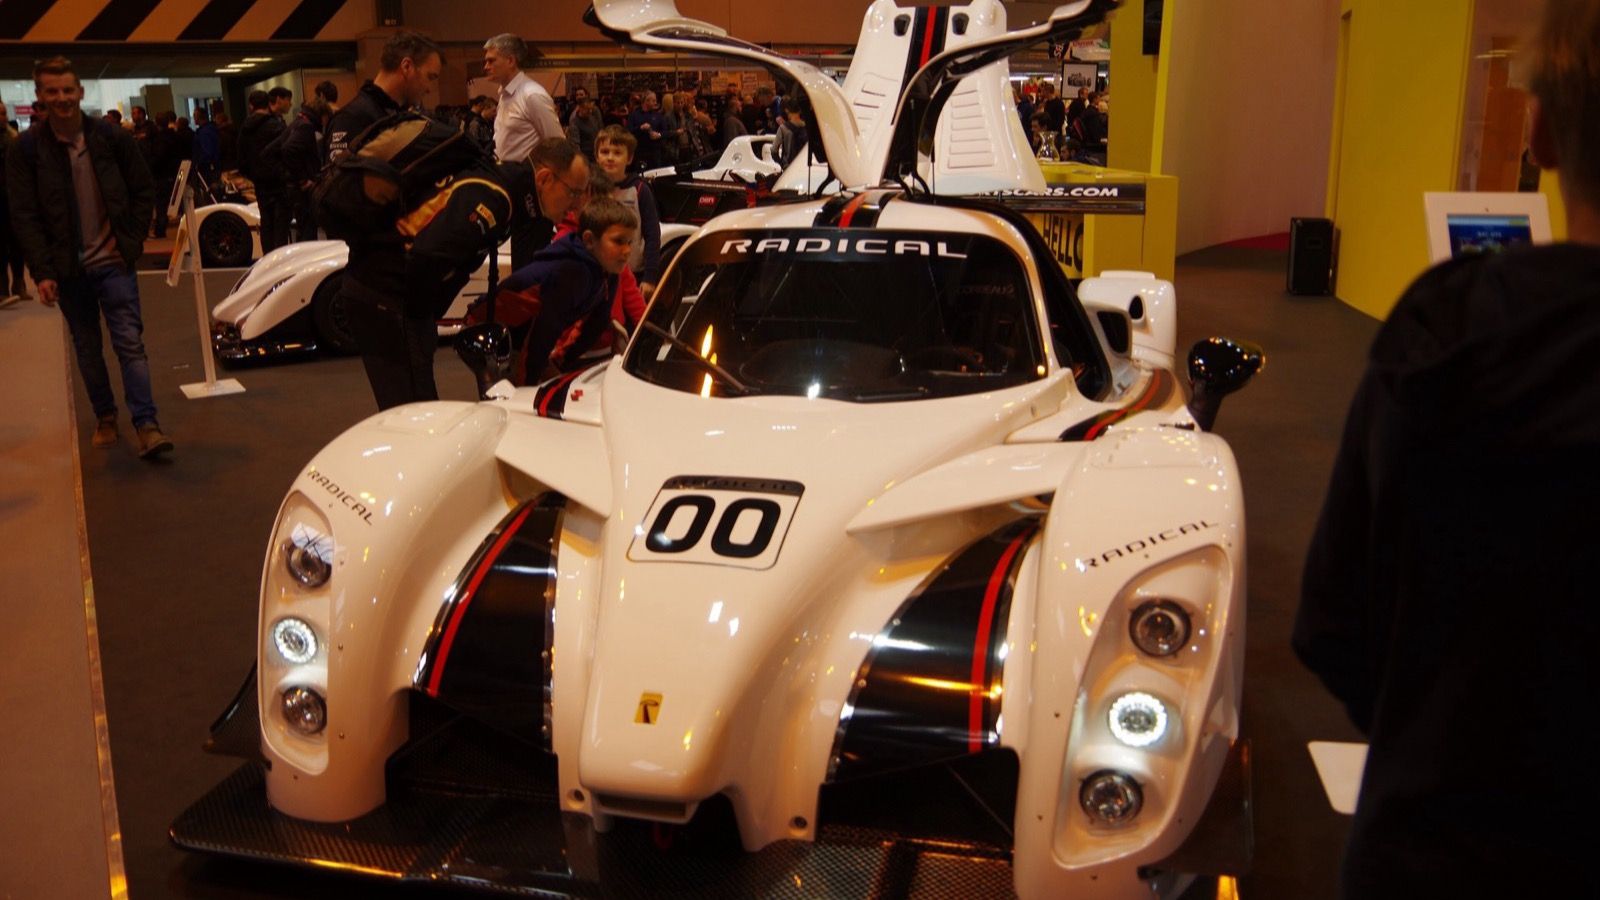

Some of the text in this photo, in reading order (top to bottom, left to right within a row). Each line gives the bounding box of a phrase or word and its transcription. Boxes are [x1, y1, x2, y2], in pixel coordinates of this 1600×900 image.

[720, 238, 968, 258] RADICAL
[307, 469, 373, 526] RADICAL
[645, 494, 781, 559] 00
[1076, 520, 1219, 567] RADICAL
